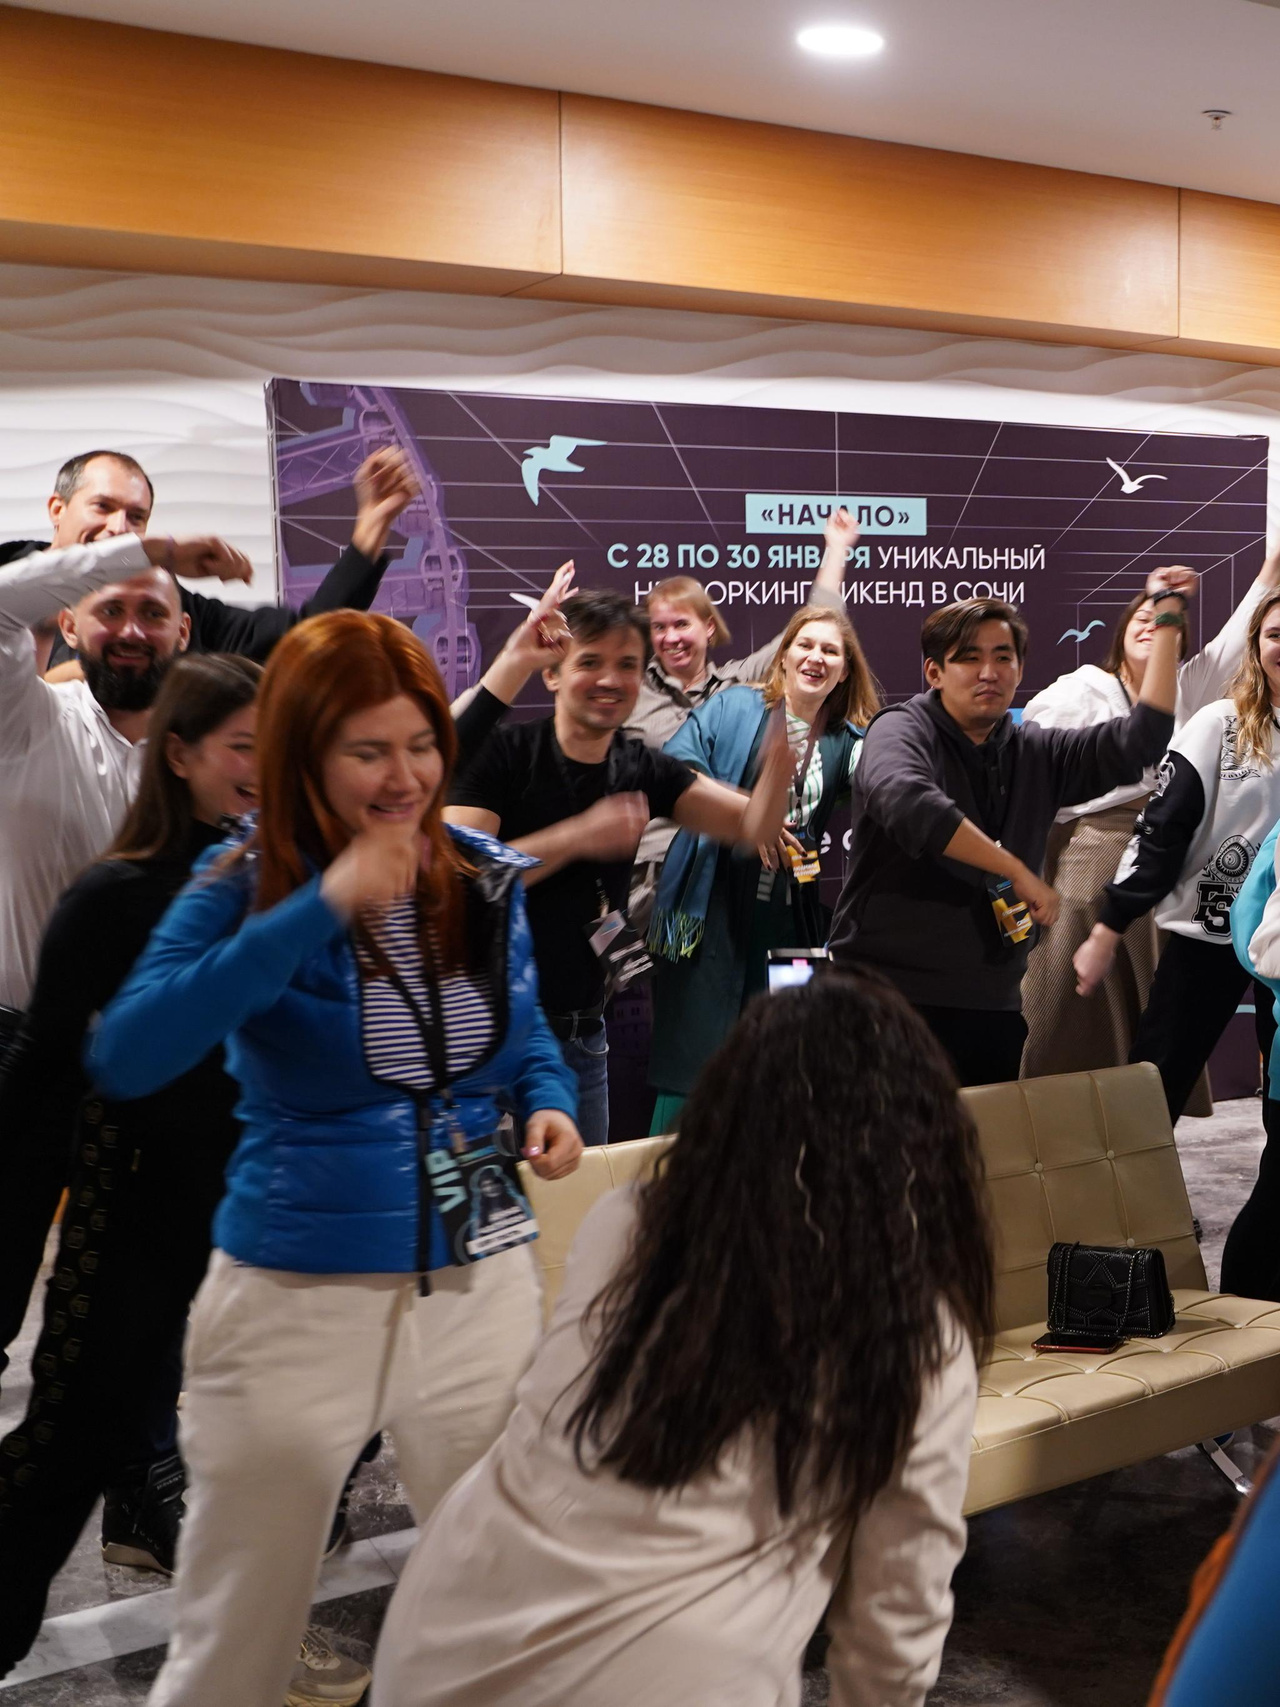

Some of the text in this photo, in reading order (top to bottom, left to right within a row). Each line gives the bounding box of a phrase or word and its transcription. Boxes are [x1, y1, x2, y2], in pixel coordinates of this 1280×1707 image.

[761, 503, 909, 526] «НАЧЛО»
[607, 543, 1045, 570] С 28 ПО 30 ЯНВРЯ УНИКАЛЬНЫЙ
[839, 581, 925, 607] ИКЕНД
[932, 582, 947, 604] В
[953, 582, 1025, 604] СОЧИ
[425, 1150, 468, 1213] VIP
